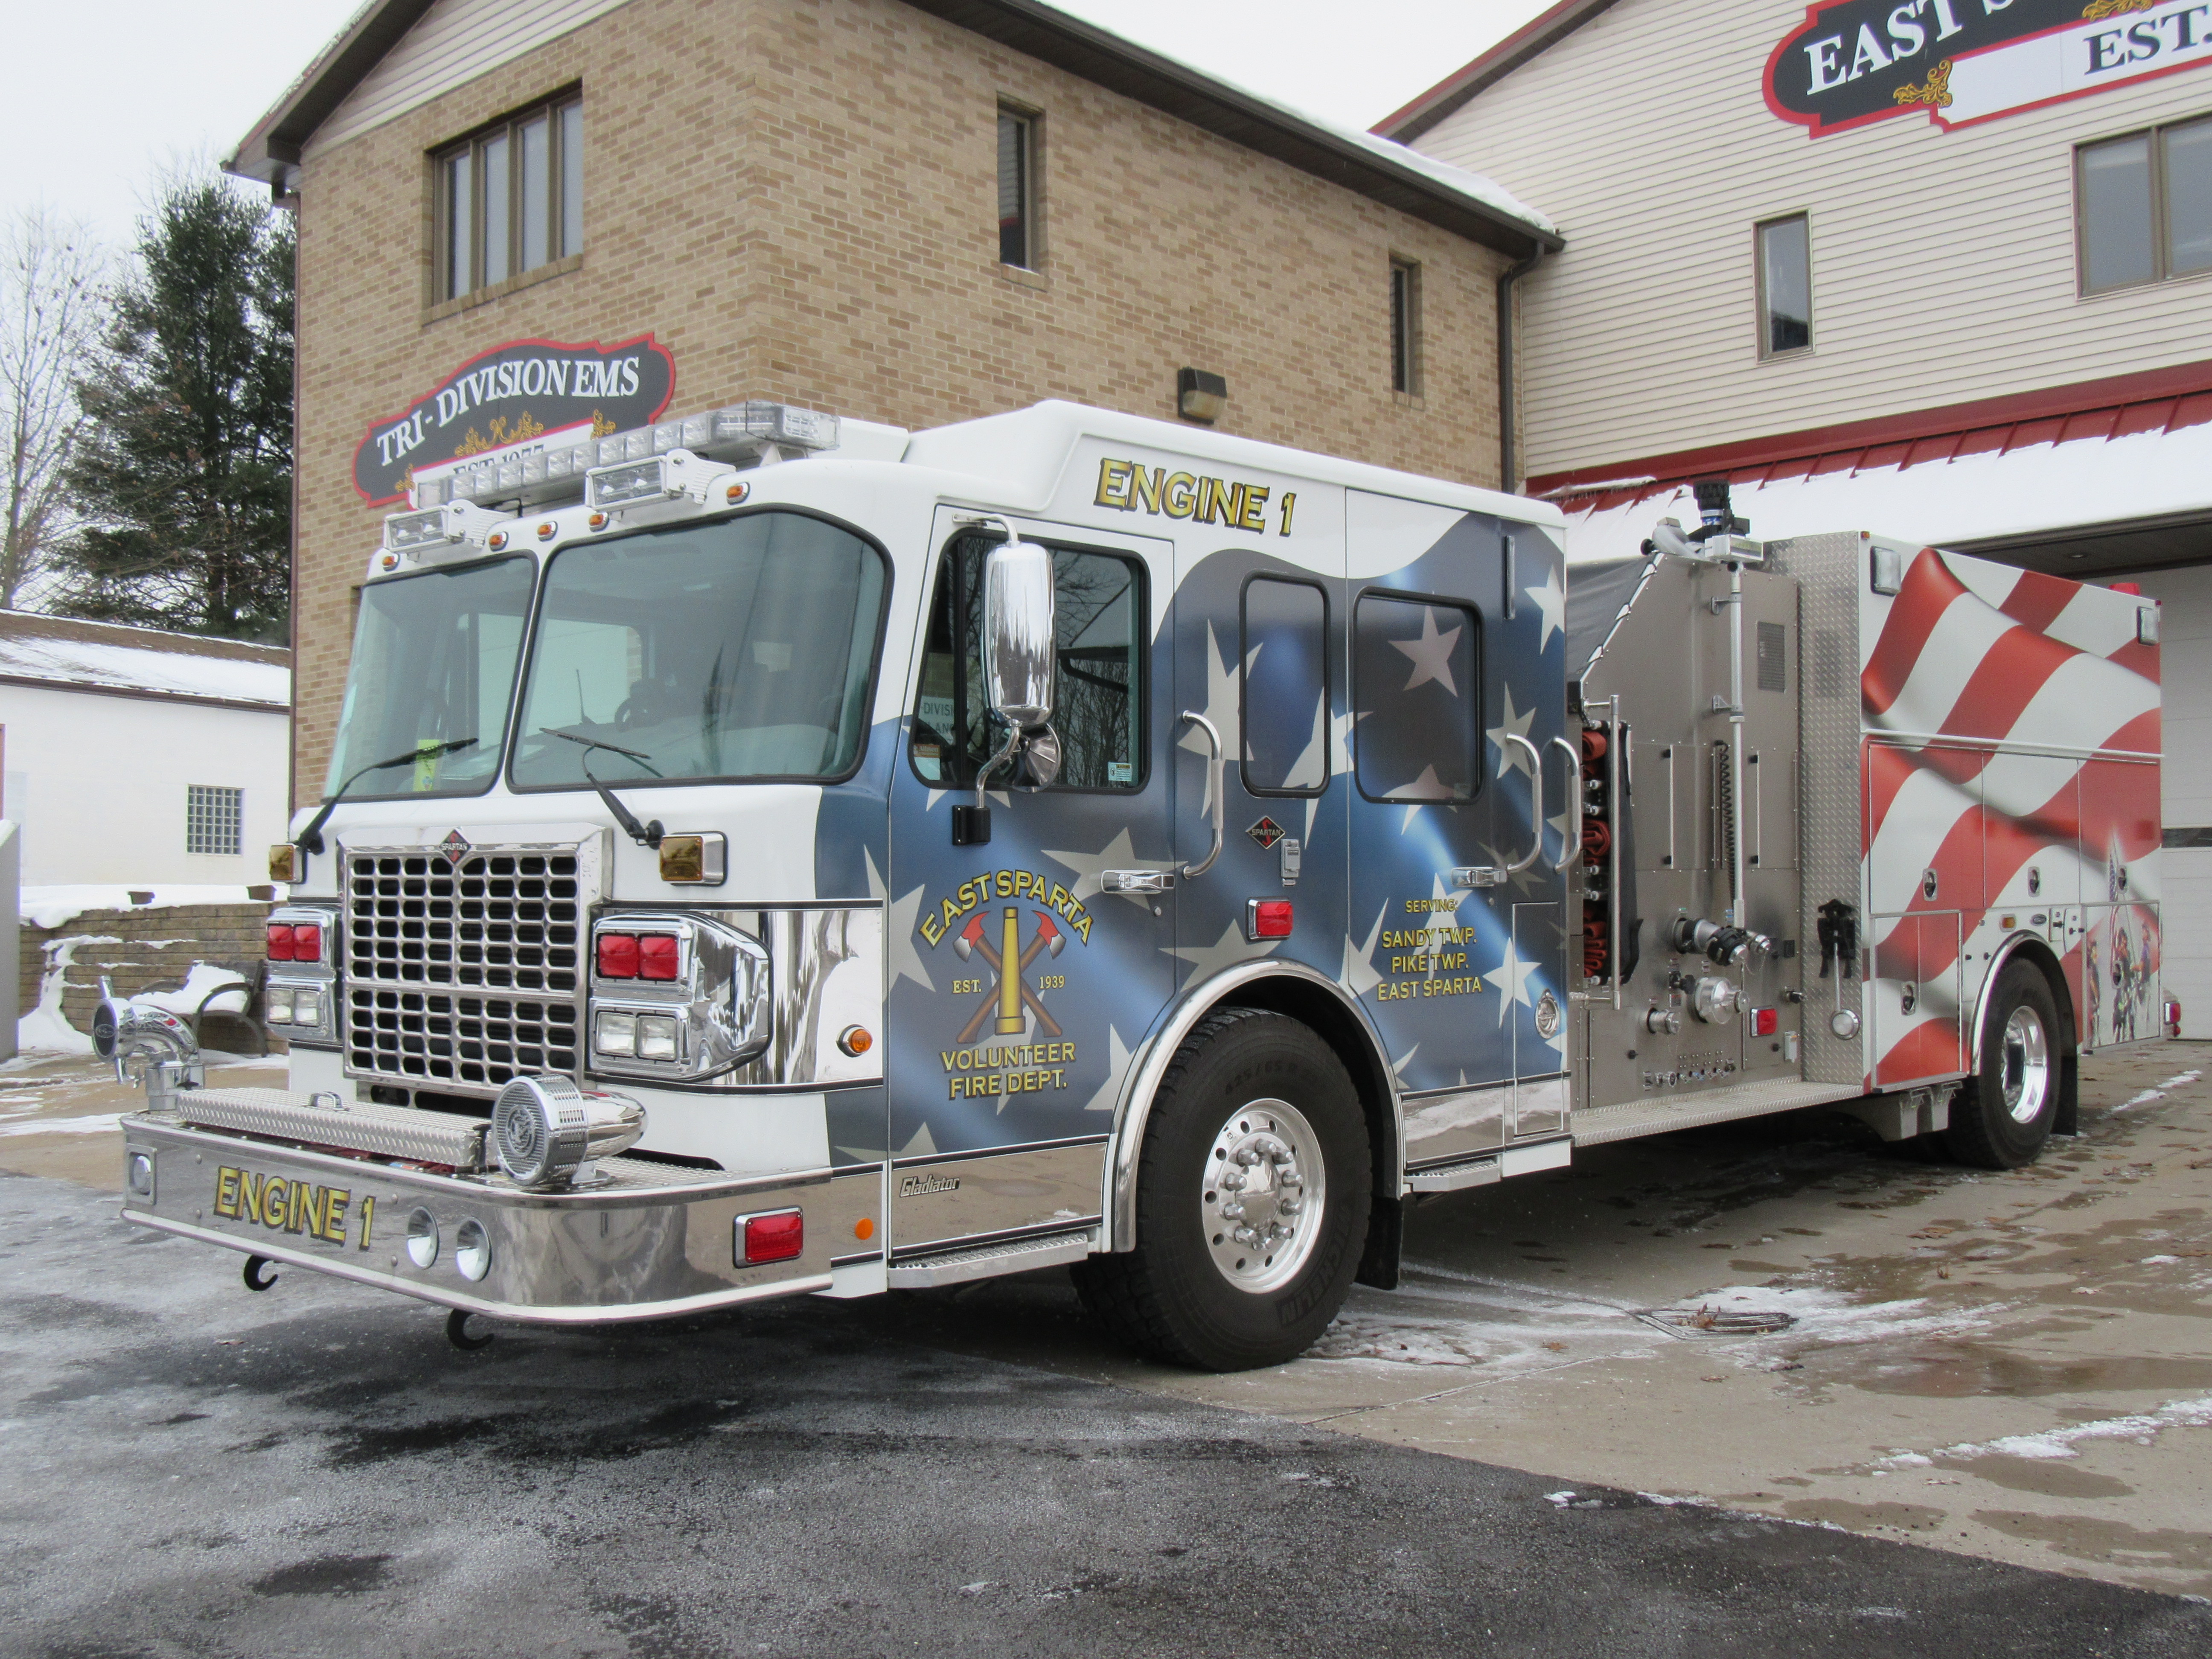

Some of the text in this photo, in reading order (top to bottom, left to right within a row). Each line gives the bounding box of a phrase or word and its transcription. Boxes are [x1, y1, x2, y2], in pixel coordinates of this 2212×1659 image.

[1804, 0, 1963, 96] EAST
[572, 357, 639, 397] EMS
[1093, 457, 1297, 537] ENGINE 1
[441, 843, 468, 851] SPARTAN
[920, 869, 1094, 948] EAST SPARTA
[1406, 899, 1459, 913] SERVING:
[1382, 927, 1478, 949] SANDY TWP.
[1391, 952, 1470, 974] PIKE TWP.
[952, 979, 981, 994] EST.
[1039, 975, 1065, 990] 1939
[1377, 976, 1483, 1001] EAST SPARTA
[942, 1042, 1076, 1072] VOLUNTEER
[949, 1068, 1068, 1101] FIRE DEPT.
[899, 1174, 960, 1198] Gladiator
[214, 1165, 376, 1252] ENGINE 1
